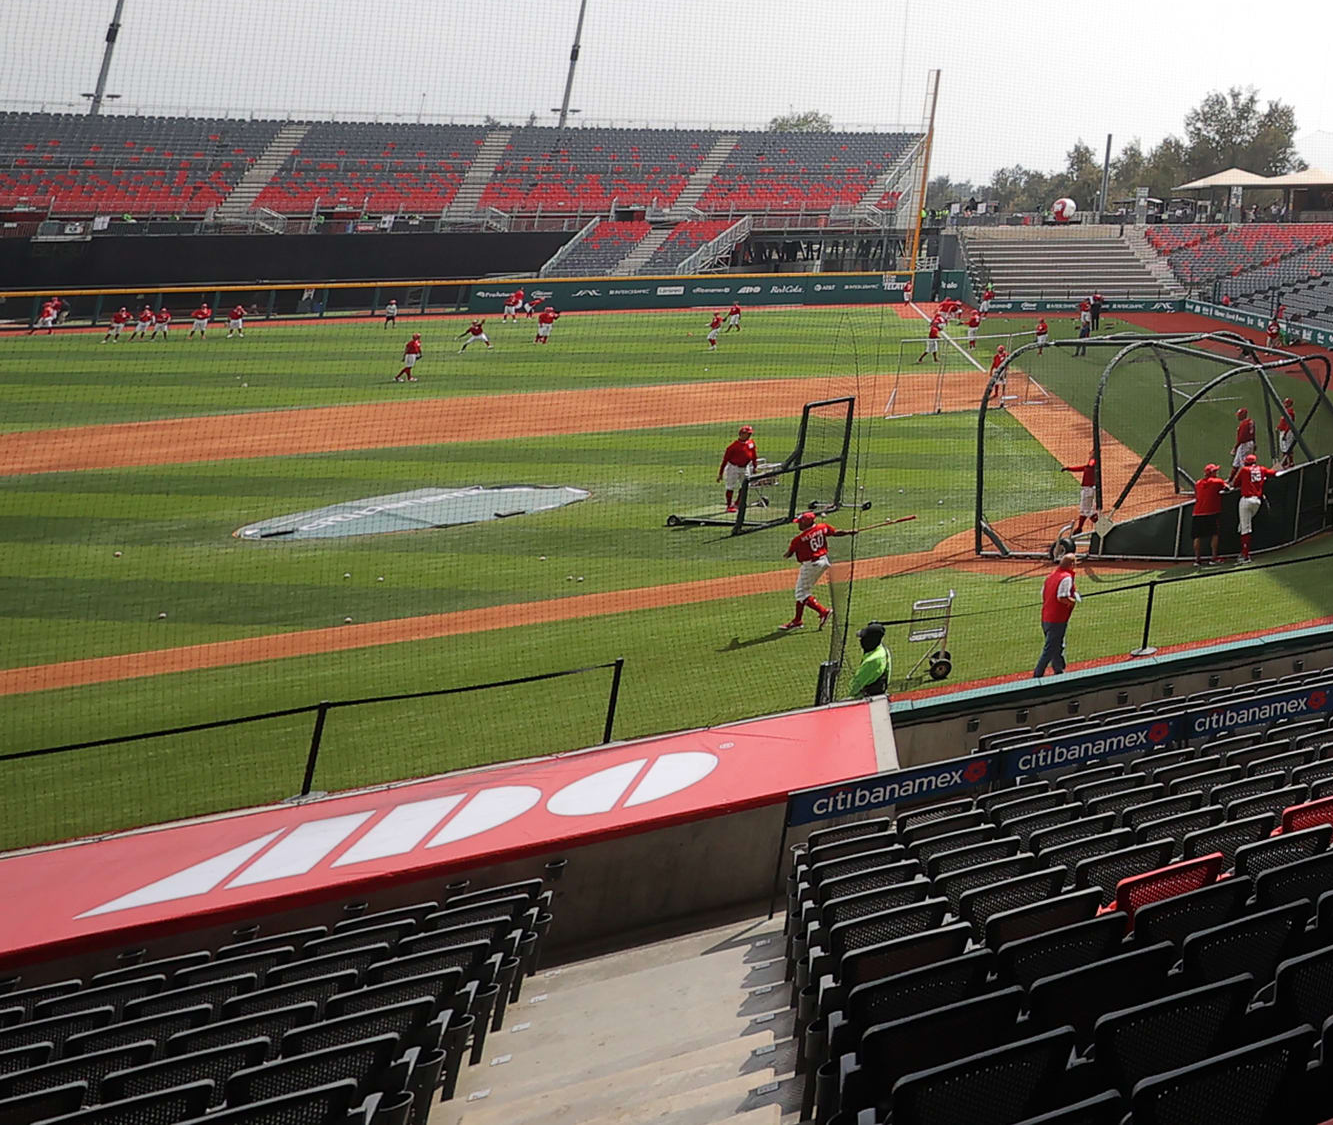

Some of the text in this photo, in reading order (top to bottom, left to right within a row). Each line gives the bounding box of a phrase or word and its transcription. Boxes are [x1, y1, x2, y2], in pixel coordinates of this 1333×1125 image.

[1195, 696, 1307, 733] citibanamex
[1018, 730, 1147, 771] citibanamex
[813, 768, 963, 816] citibanamex
